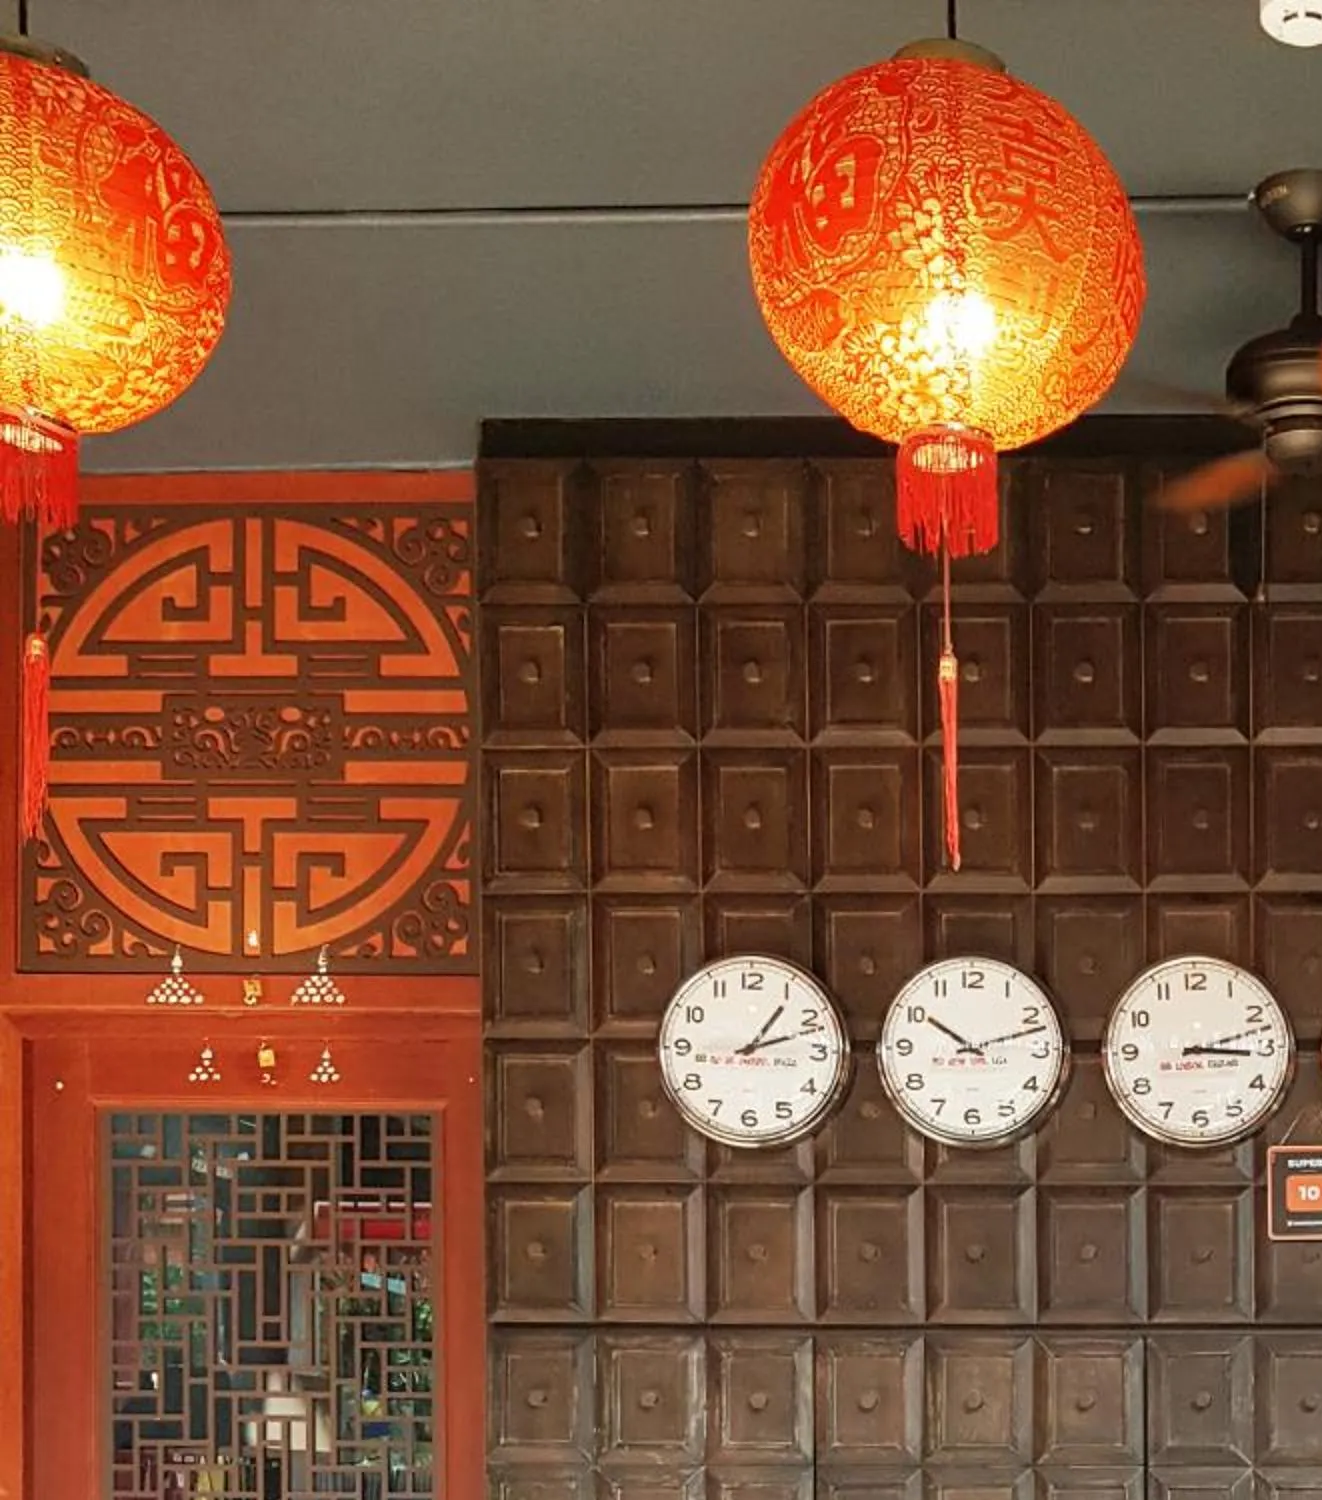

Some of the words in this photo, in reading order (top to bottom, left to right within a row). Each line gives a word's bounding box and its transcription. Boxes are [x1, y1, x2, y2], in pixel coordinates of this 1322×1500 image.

[714, 980, 726, 998] 11
[742, 973, 764, 990] 12
[934, 980, 946, 997] 11
[962, 972, 984, 989] 12
[1005, 980, 1010, 998] 1
[1184, 973, 1206, 990] 12
[1227, 980, 1233, 998] 1
[784, 982, 789, 1000] 1
[1158, 983, 1170, 1000] 11
[687, 1006, 704, 1023] 10
[801, 1009, 819, 1028] 2
[908, 1006, 925, 1023] 10
[1022, 1007, 1039, 1024] 2
[1132, 1010, 1149, 1028] 10
[1246, 1006, 1263, 1023] 2
[674, 1038, 691, 1056] 9
[810, 1044, 828, 1061] 3
[896, 1039, 913, 1056] 9
[1122, 1044, 1139, 1061] 9
[1257, 1039, 1275, 1057] 3
[683, 1074, 702, 1090] 8
[800, 1078, 817, 1095] 4
[906, 1074, 924, 1090] 8
[1023, 1076, 1038, 1092] 4
[1133, 1078, 1151, 1095] 8
[1249, 1074, 1266, 1091] 4
[708, 1099, 722, 1116] 7
[776, 1102, 792, 1119] 5
[931, 1099, 946, 1115] 7
[1158, 1102, 1174, 1119] 7
[1226, 1100, 1243, 1117] 5
[741, 1110, 758, 1127] 6
[964, 1109, 981, 1124] 6
[1192, 1110, 1209, 1128] 6
[1297, 1185, 1321, 1201] 10
